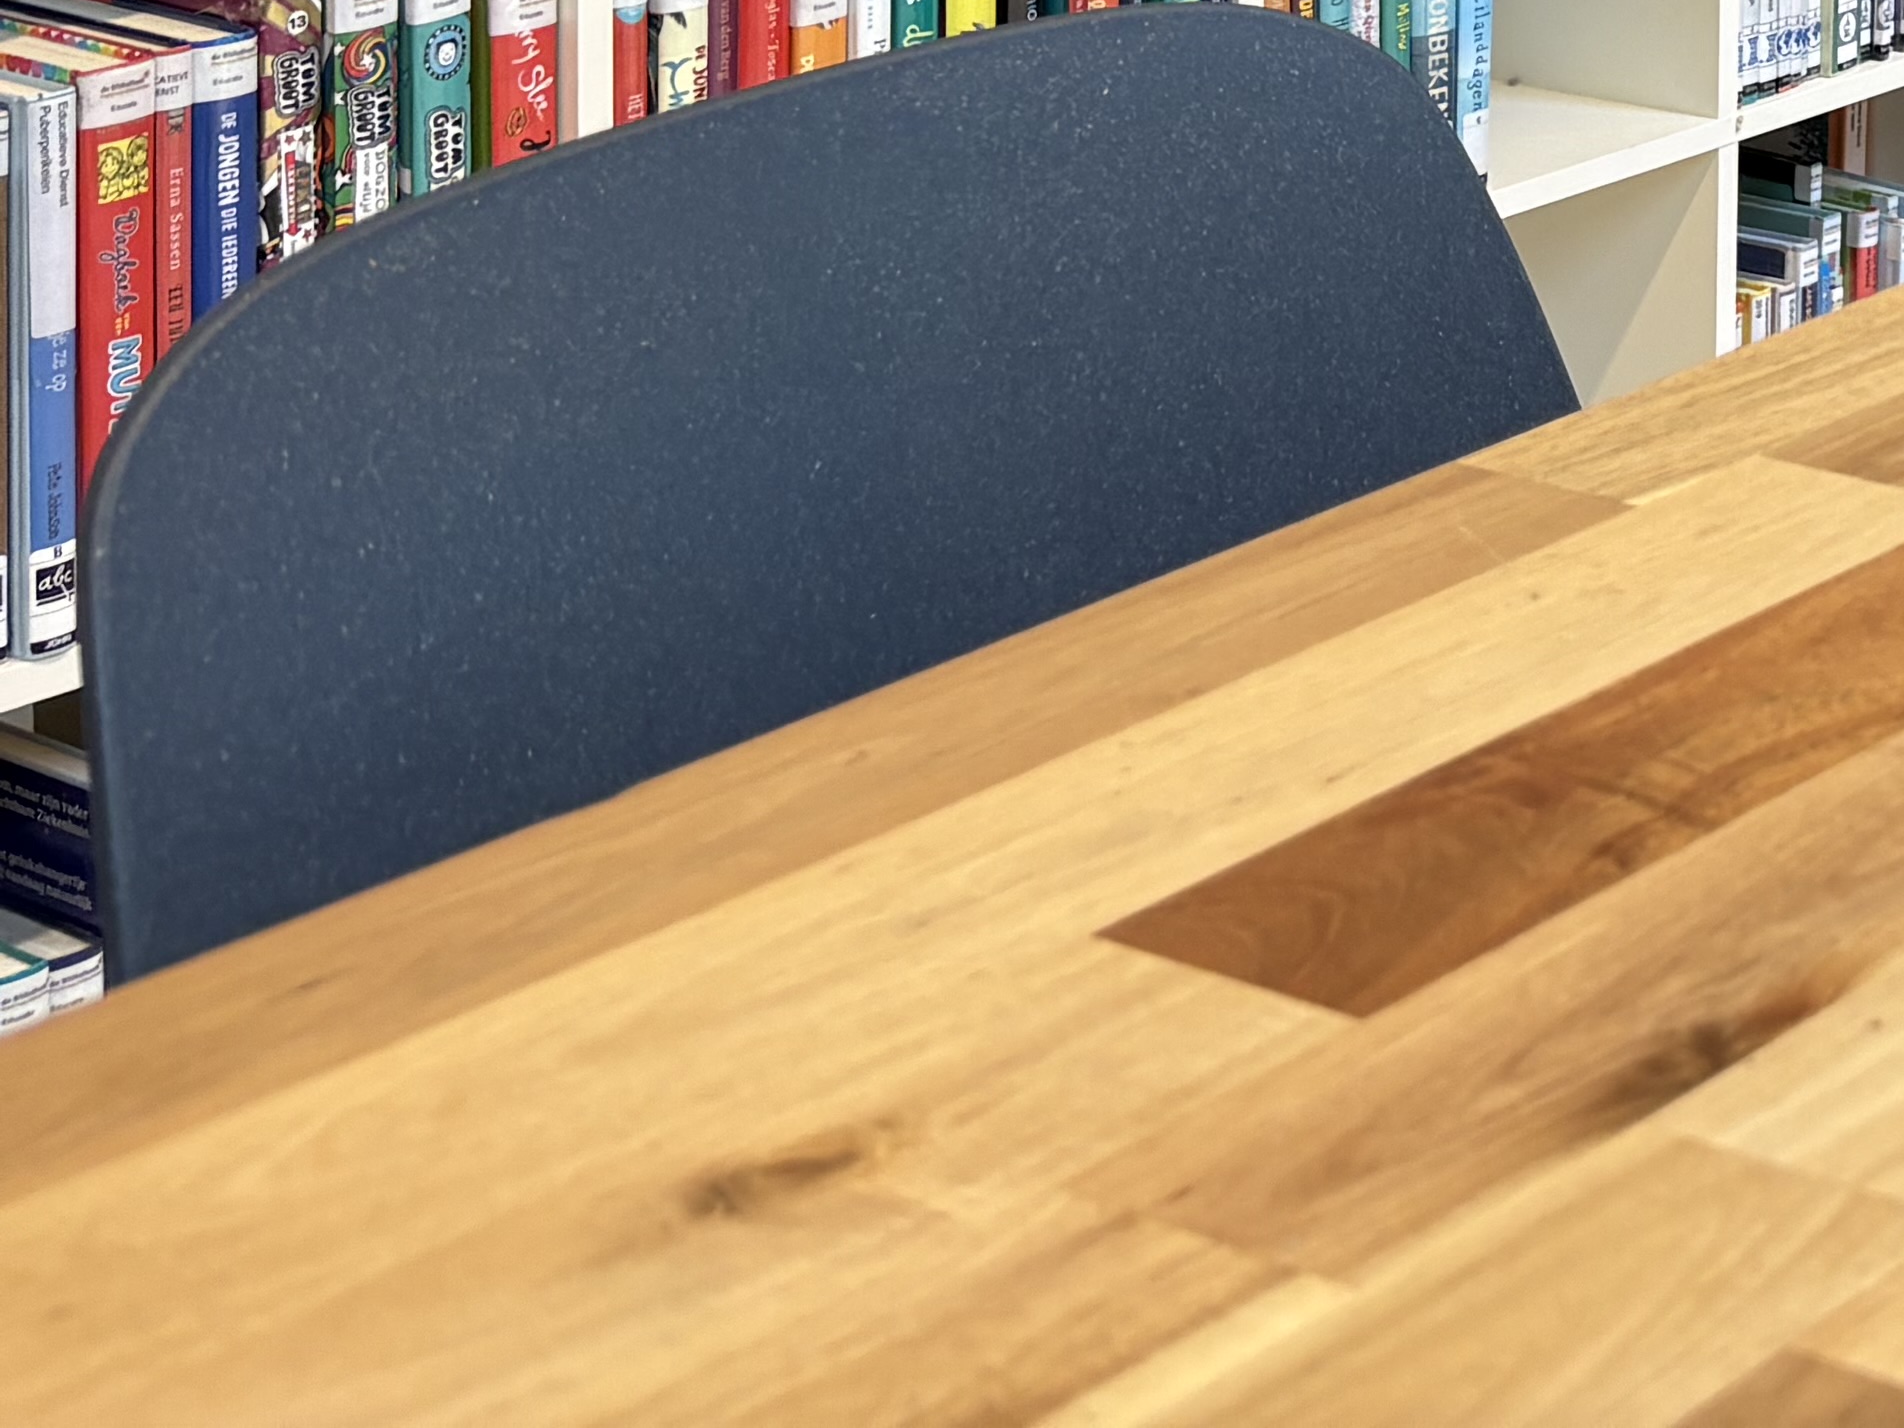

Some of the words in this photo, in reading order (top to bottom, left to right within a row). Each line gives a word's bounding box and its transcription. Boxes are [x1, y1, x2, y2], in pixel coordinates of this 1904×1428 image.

[288, 14, 307, 29] 13
[279, 57, 299, 110] GROOT
[300, 52, 317, 105] TOM
[221, 112, 237, 129] DE
[353, 89, 375, 144] GROOT
[375, 85, 391, 137] TOM
[432, 113, 450, 175] GROOT
[451, 111, 466, 165] TOM
[169, 168, 184, 207] Erna
[218, 136, 240, 207] JONGEN
[170, 213, 184, 271] Sassen
[221, 208, 237, 232] DIE
